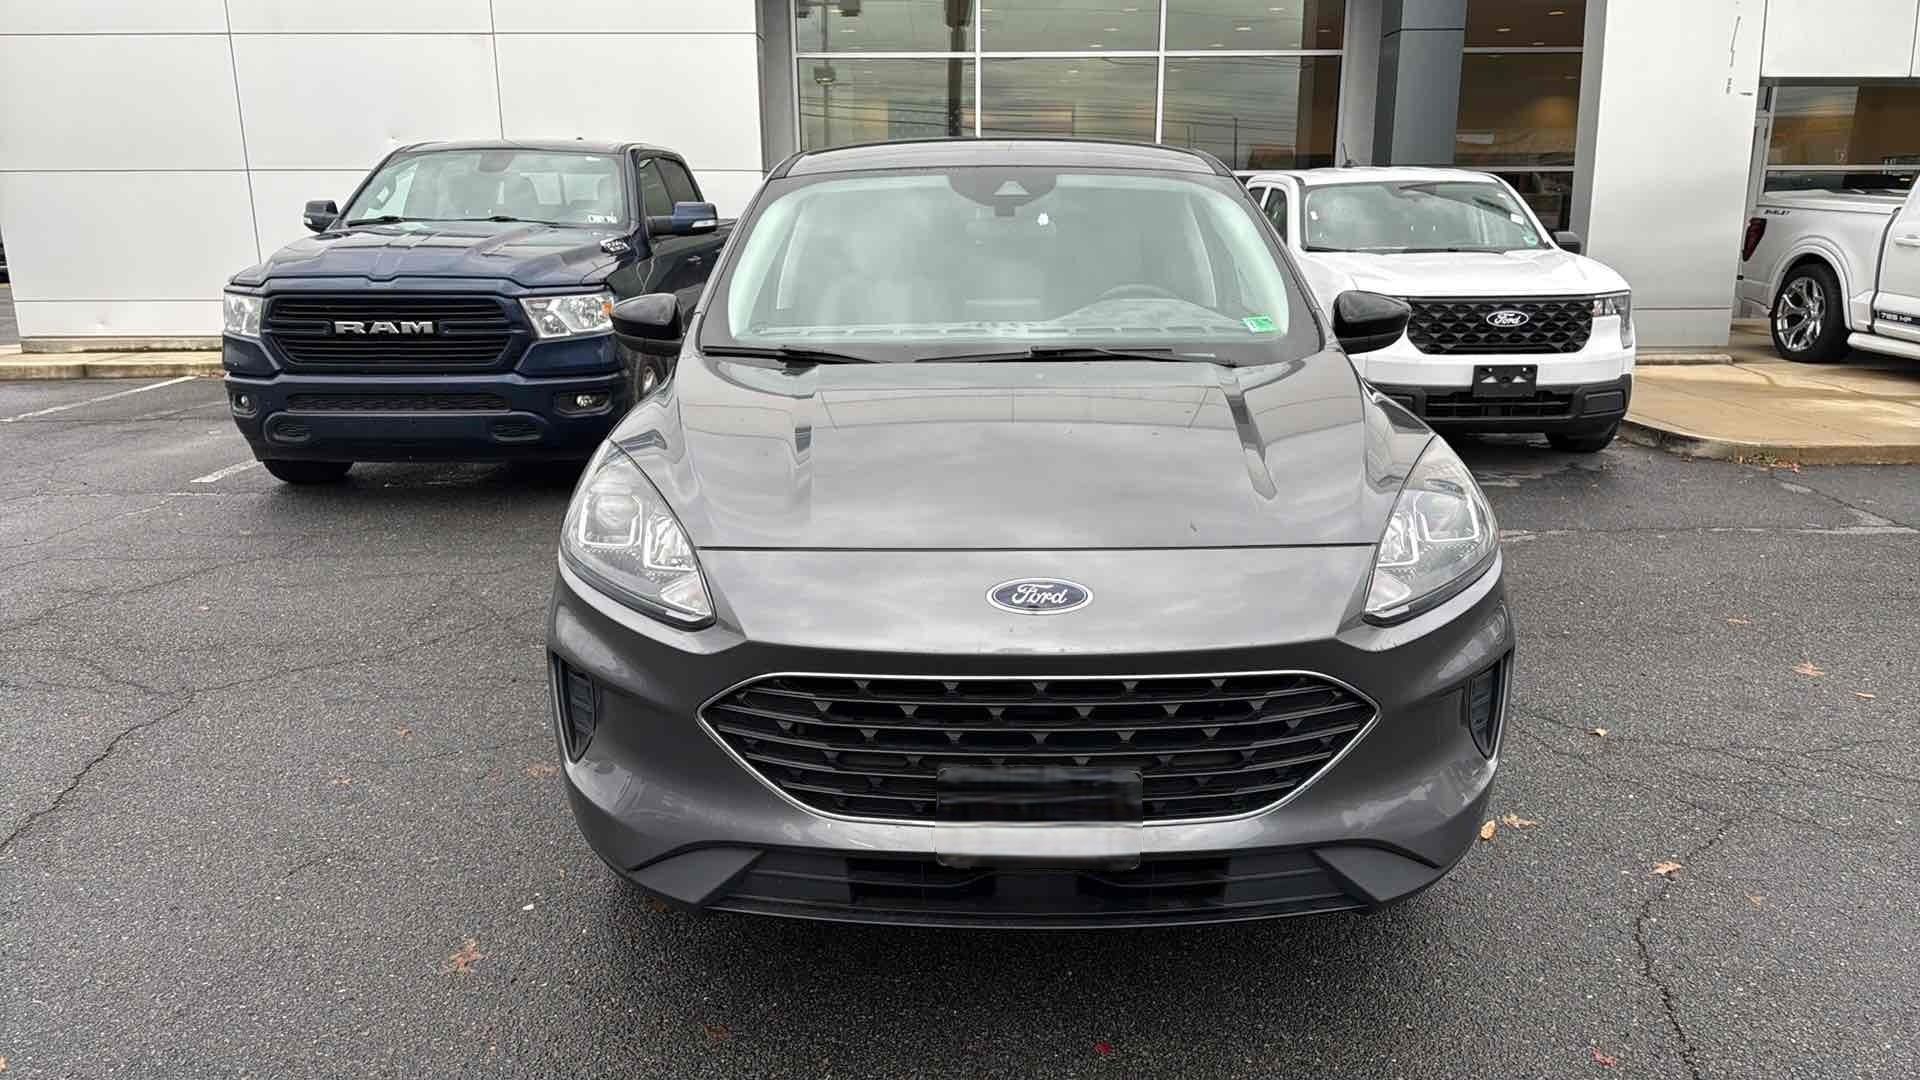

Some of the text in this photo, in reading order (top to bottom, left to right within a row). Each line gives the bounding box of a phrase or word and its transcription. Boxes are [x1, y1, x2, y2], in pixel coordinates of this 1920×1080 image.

[1494, 313, 1521, 324] Ford
[335, 321, 433, 335] RAM
[1011, 583, 1068, 604] Ford
